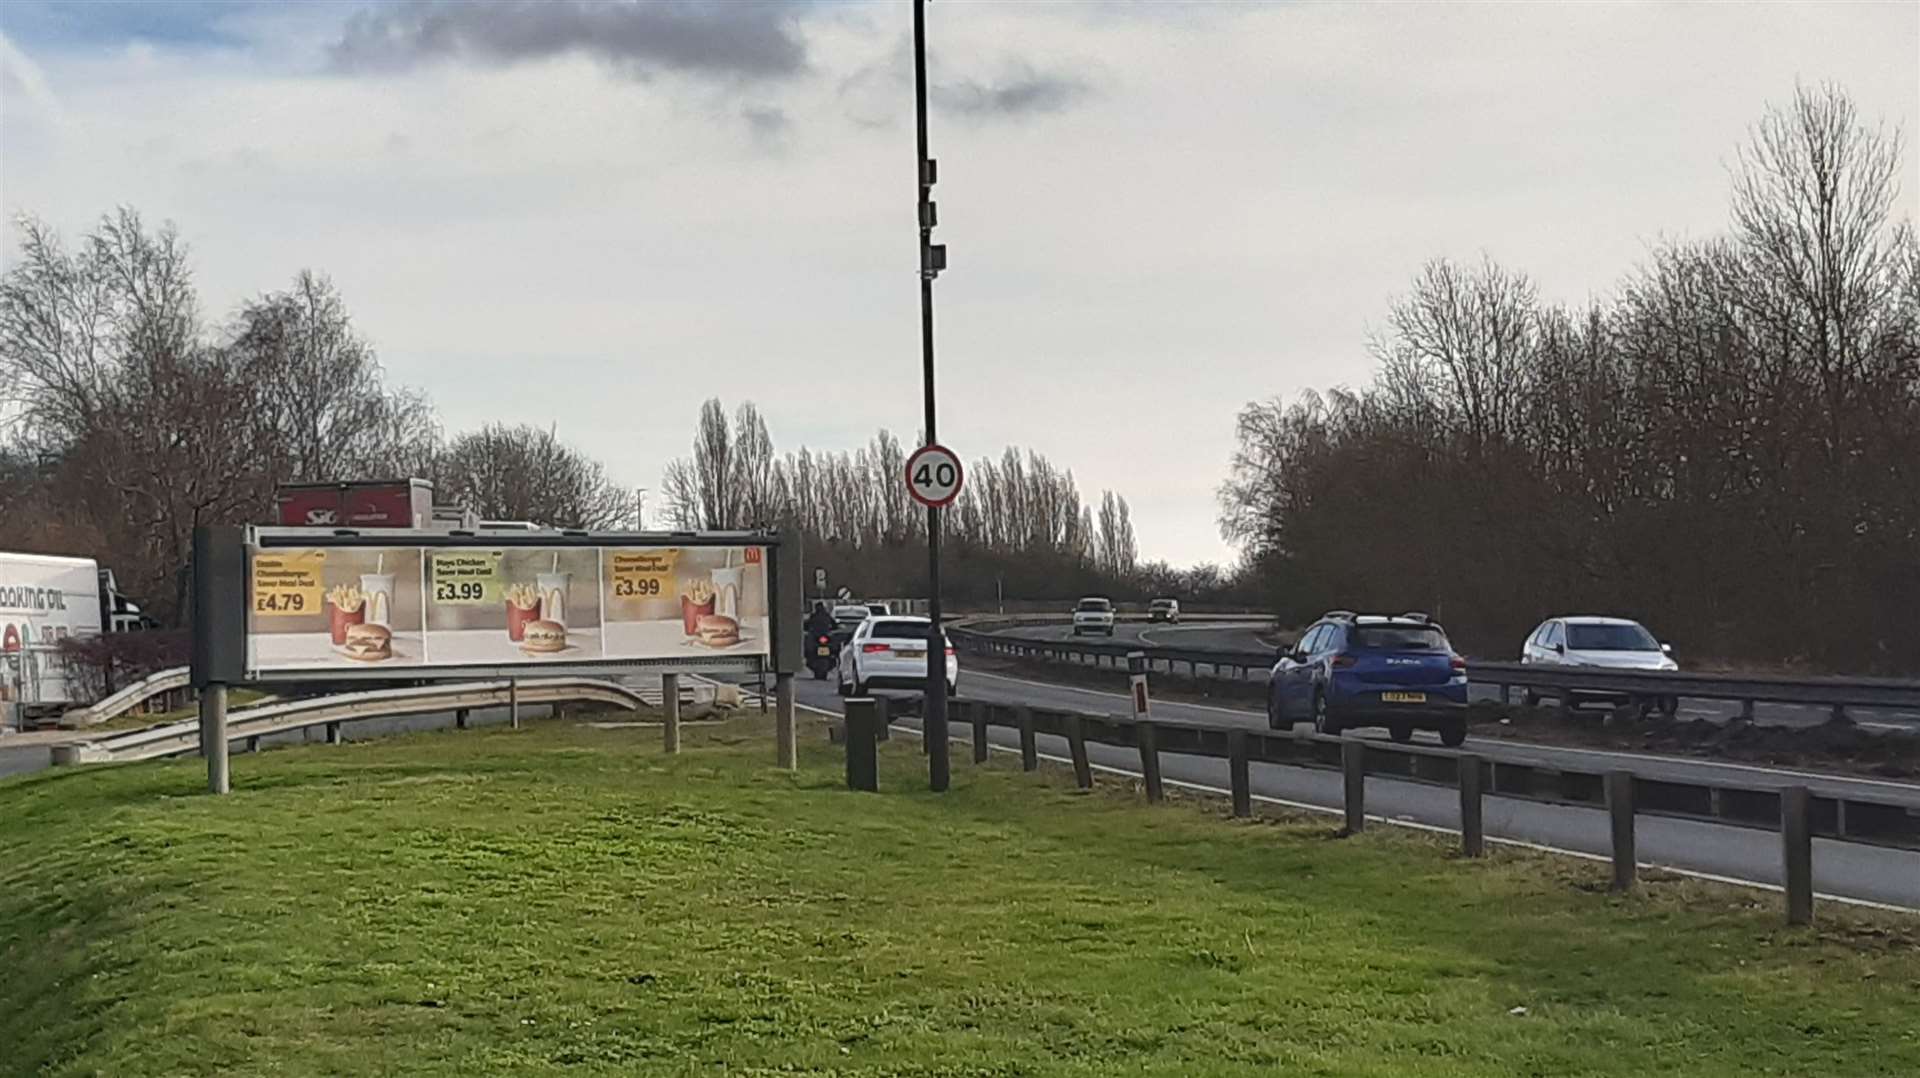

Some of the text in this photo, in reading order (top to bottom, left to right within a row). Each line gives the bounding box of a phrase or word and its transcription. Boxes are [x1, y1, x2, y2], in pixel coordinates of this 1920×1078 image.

[913, 463, 955, 488] 40
[437, 582, 482, 600] £3.99
[615, 578, 660, 596] £3.99
[256, 593, 304, 611] £4.79
